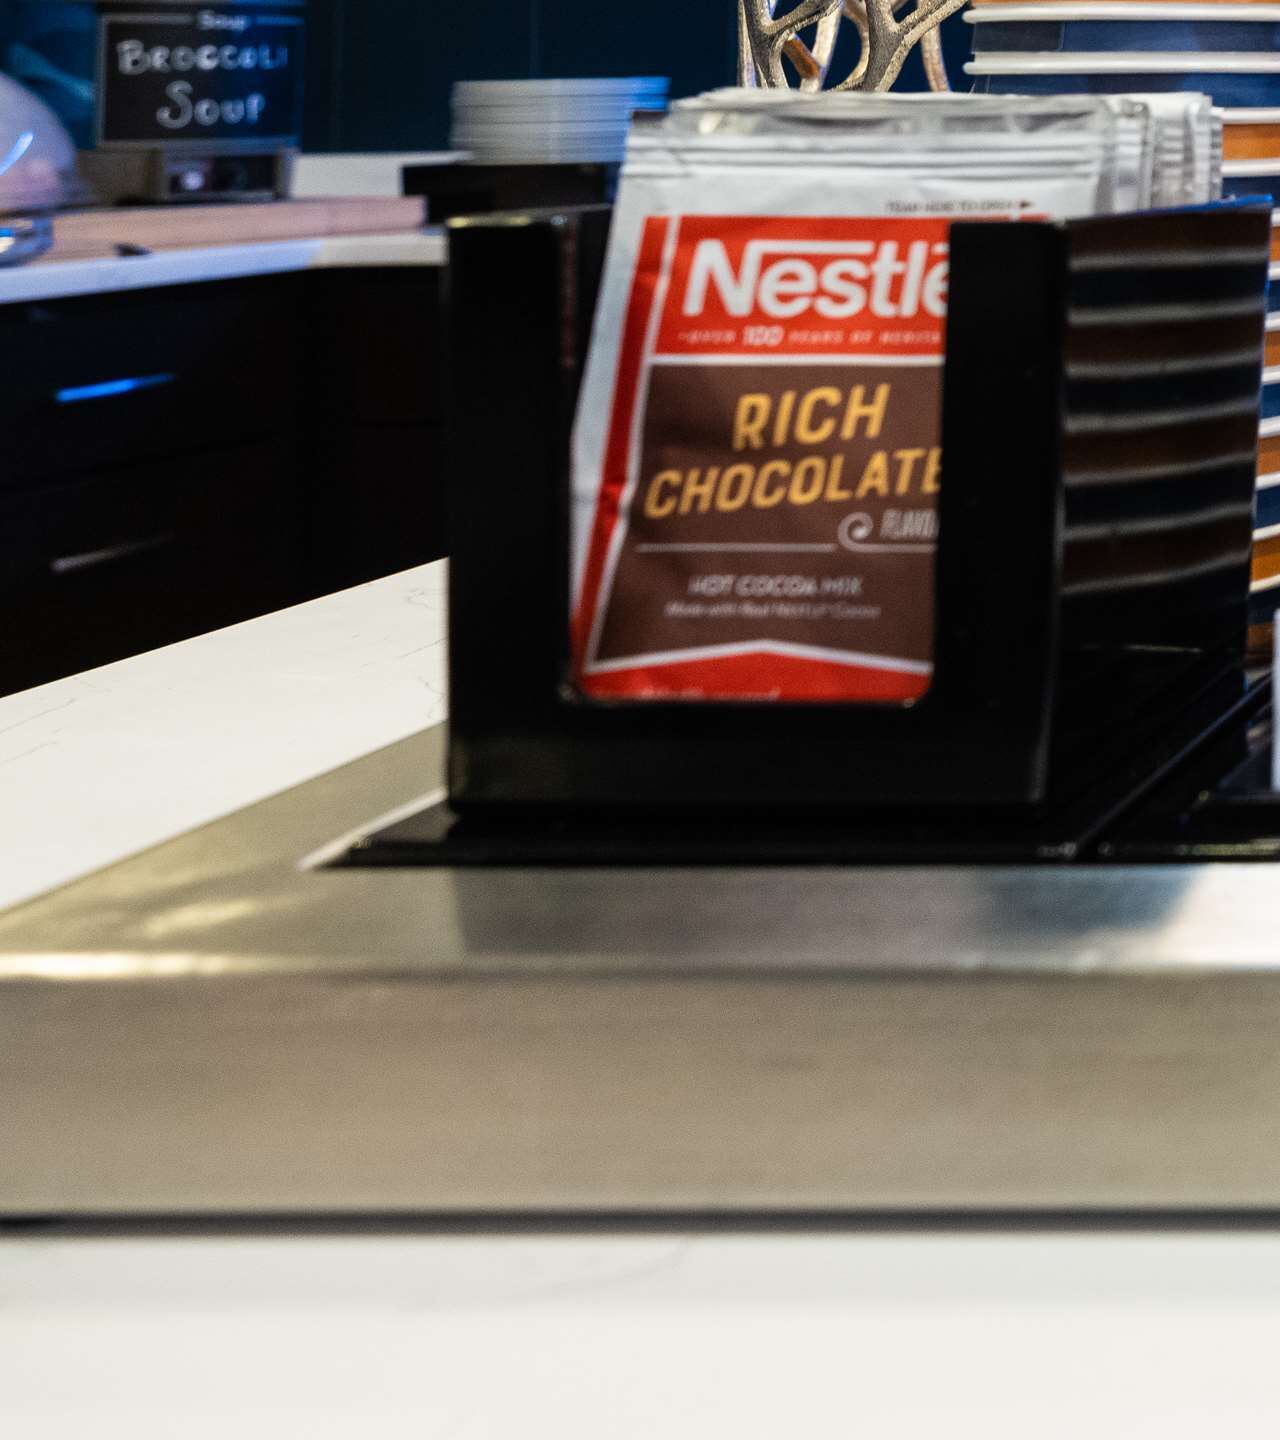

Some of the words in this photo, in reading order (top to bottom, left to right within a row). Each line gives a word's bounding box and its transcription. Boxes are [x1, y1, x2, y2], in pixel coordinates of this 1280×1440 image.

[742, 325, 784, 346] 100
[733, 382, 892, 452] RICH
[643, 446, 943, 520] CHOCOLATE
[687, 573, 735, 597] HOT
[735, 573, 818, 597] COCOA
[820, 575, 864, 595] MIX
